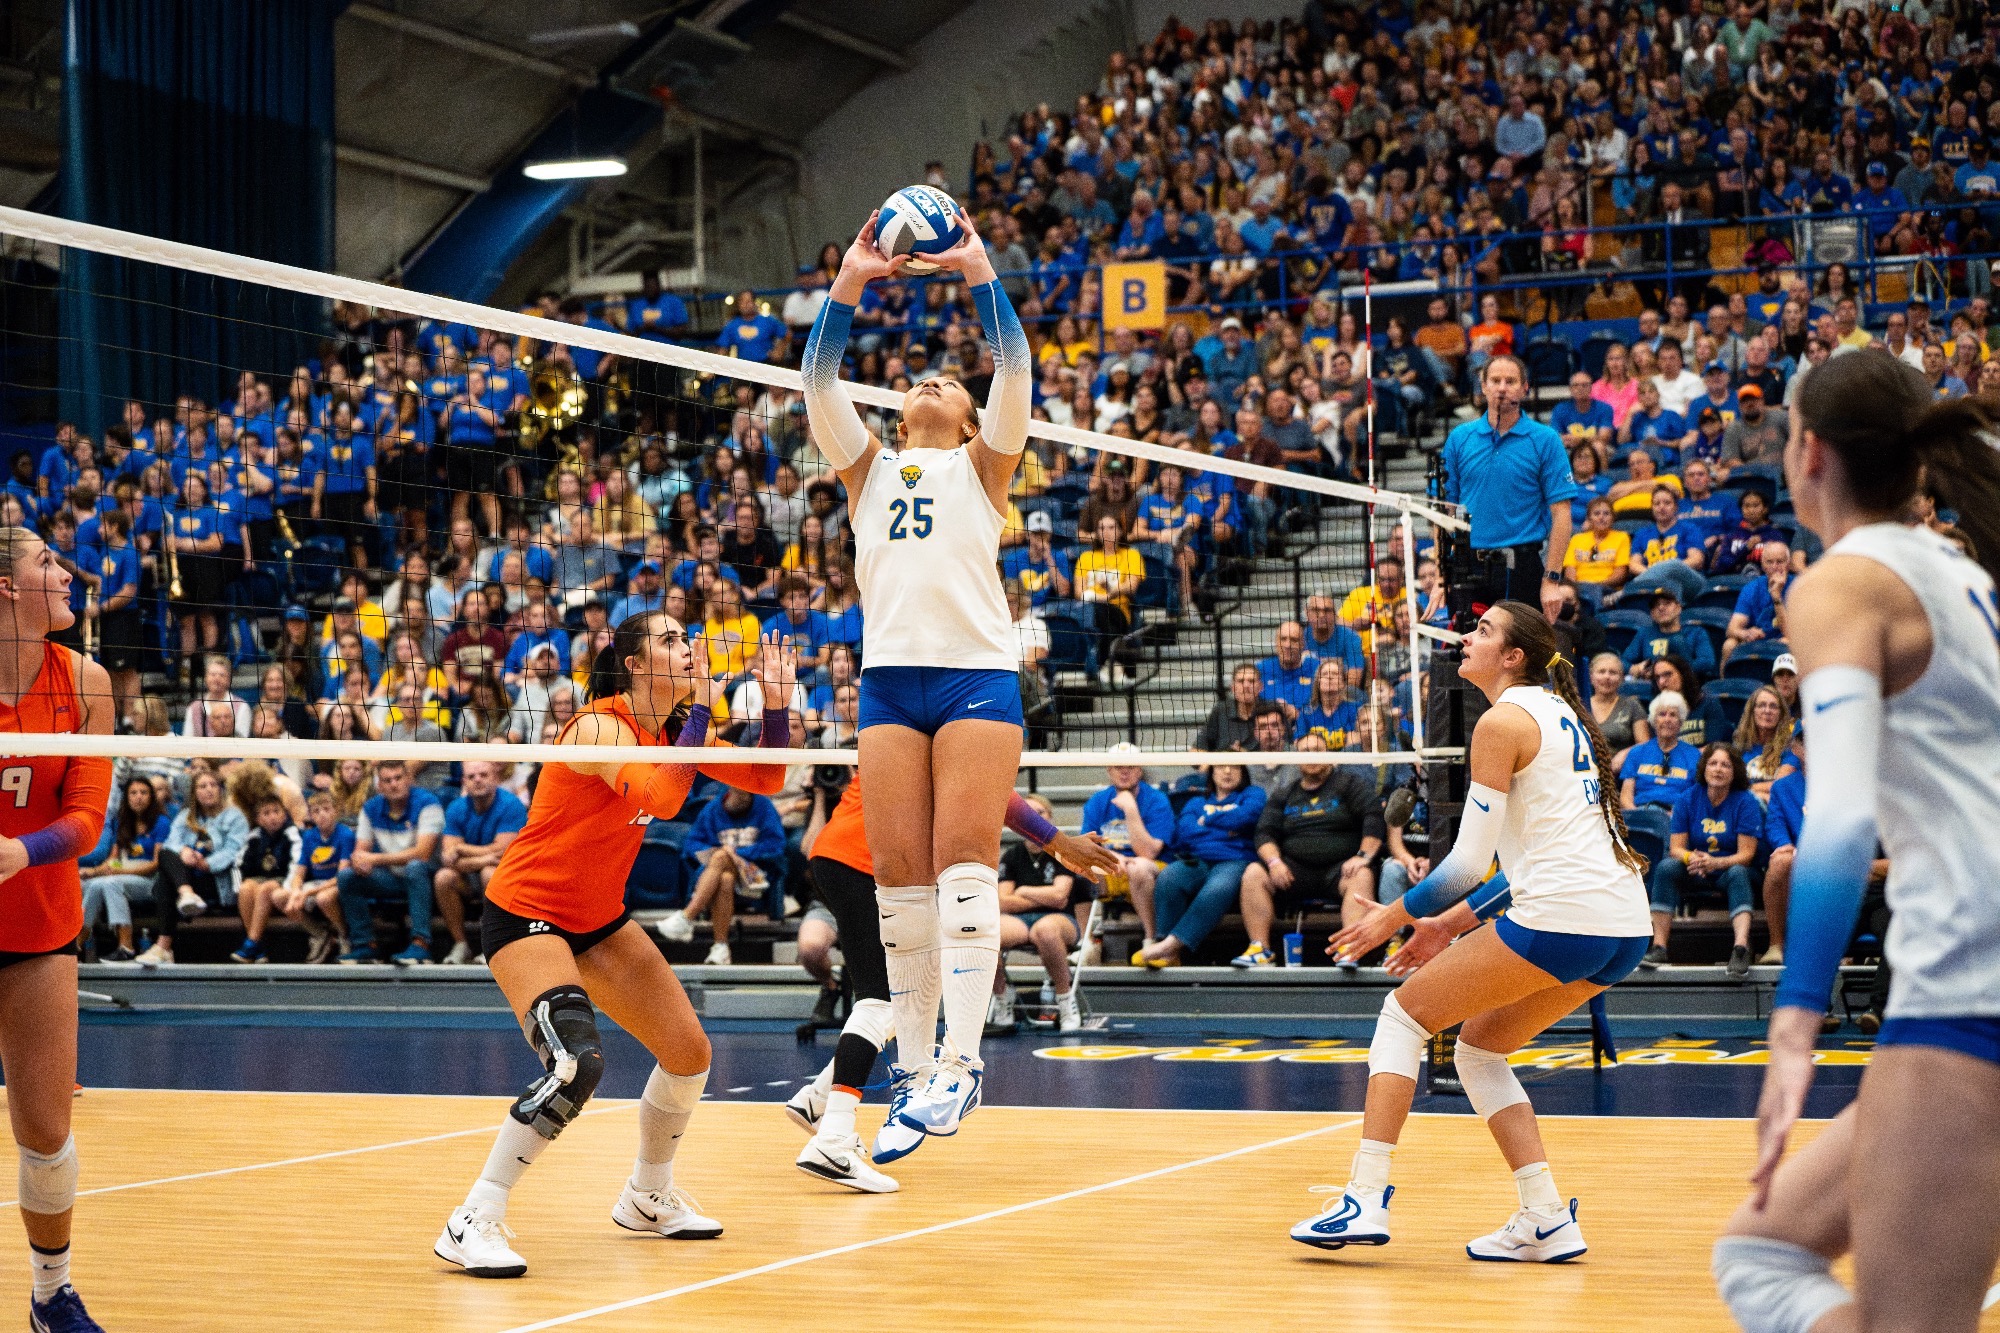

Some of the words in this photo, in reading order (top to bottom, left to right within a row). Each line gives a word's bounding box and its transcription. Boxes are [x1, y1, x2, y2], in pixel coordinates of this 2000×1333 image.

[1123, 279, 1147, 314] B
[888, 497, 934, 541] 25
[1706, 835, 1720, 853] 2
